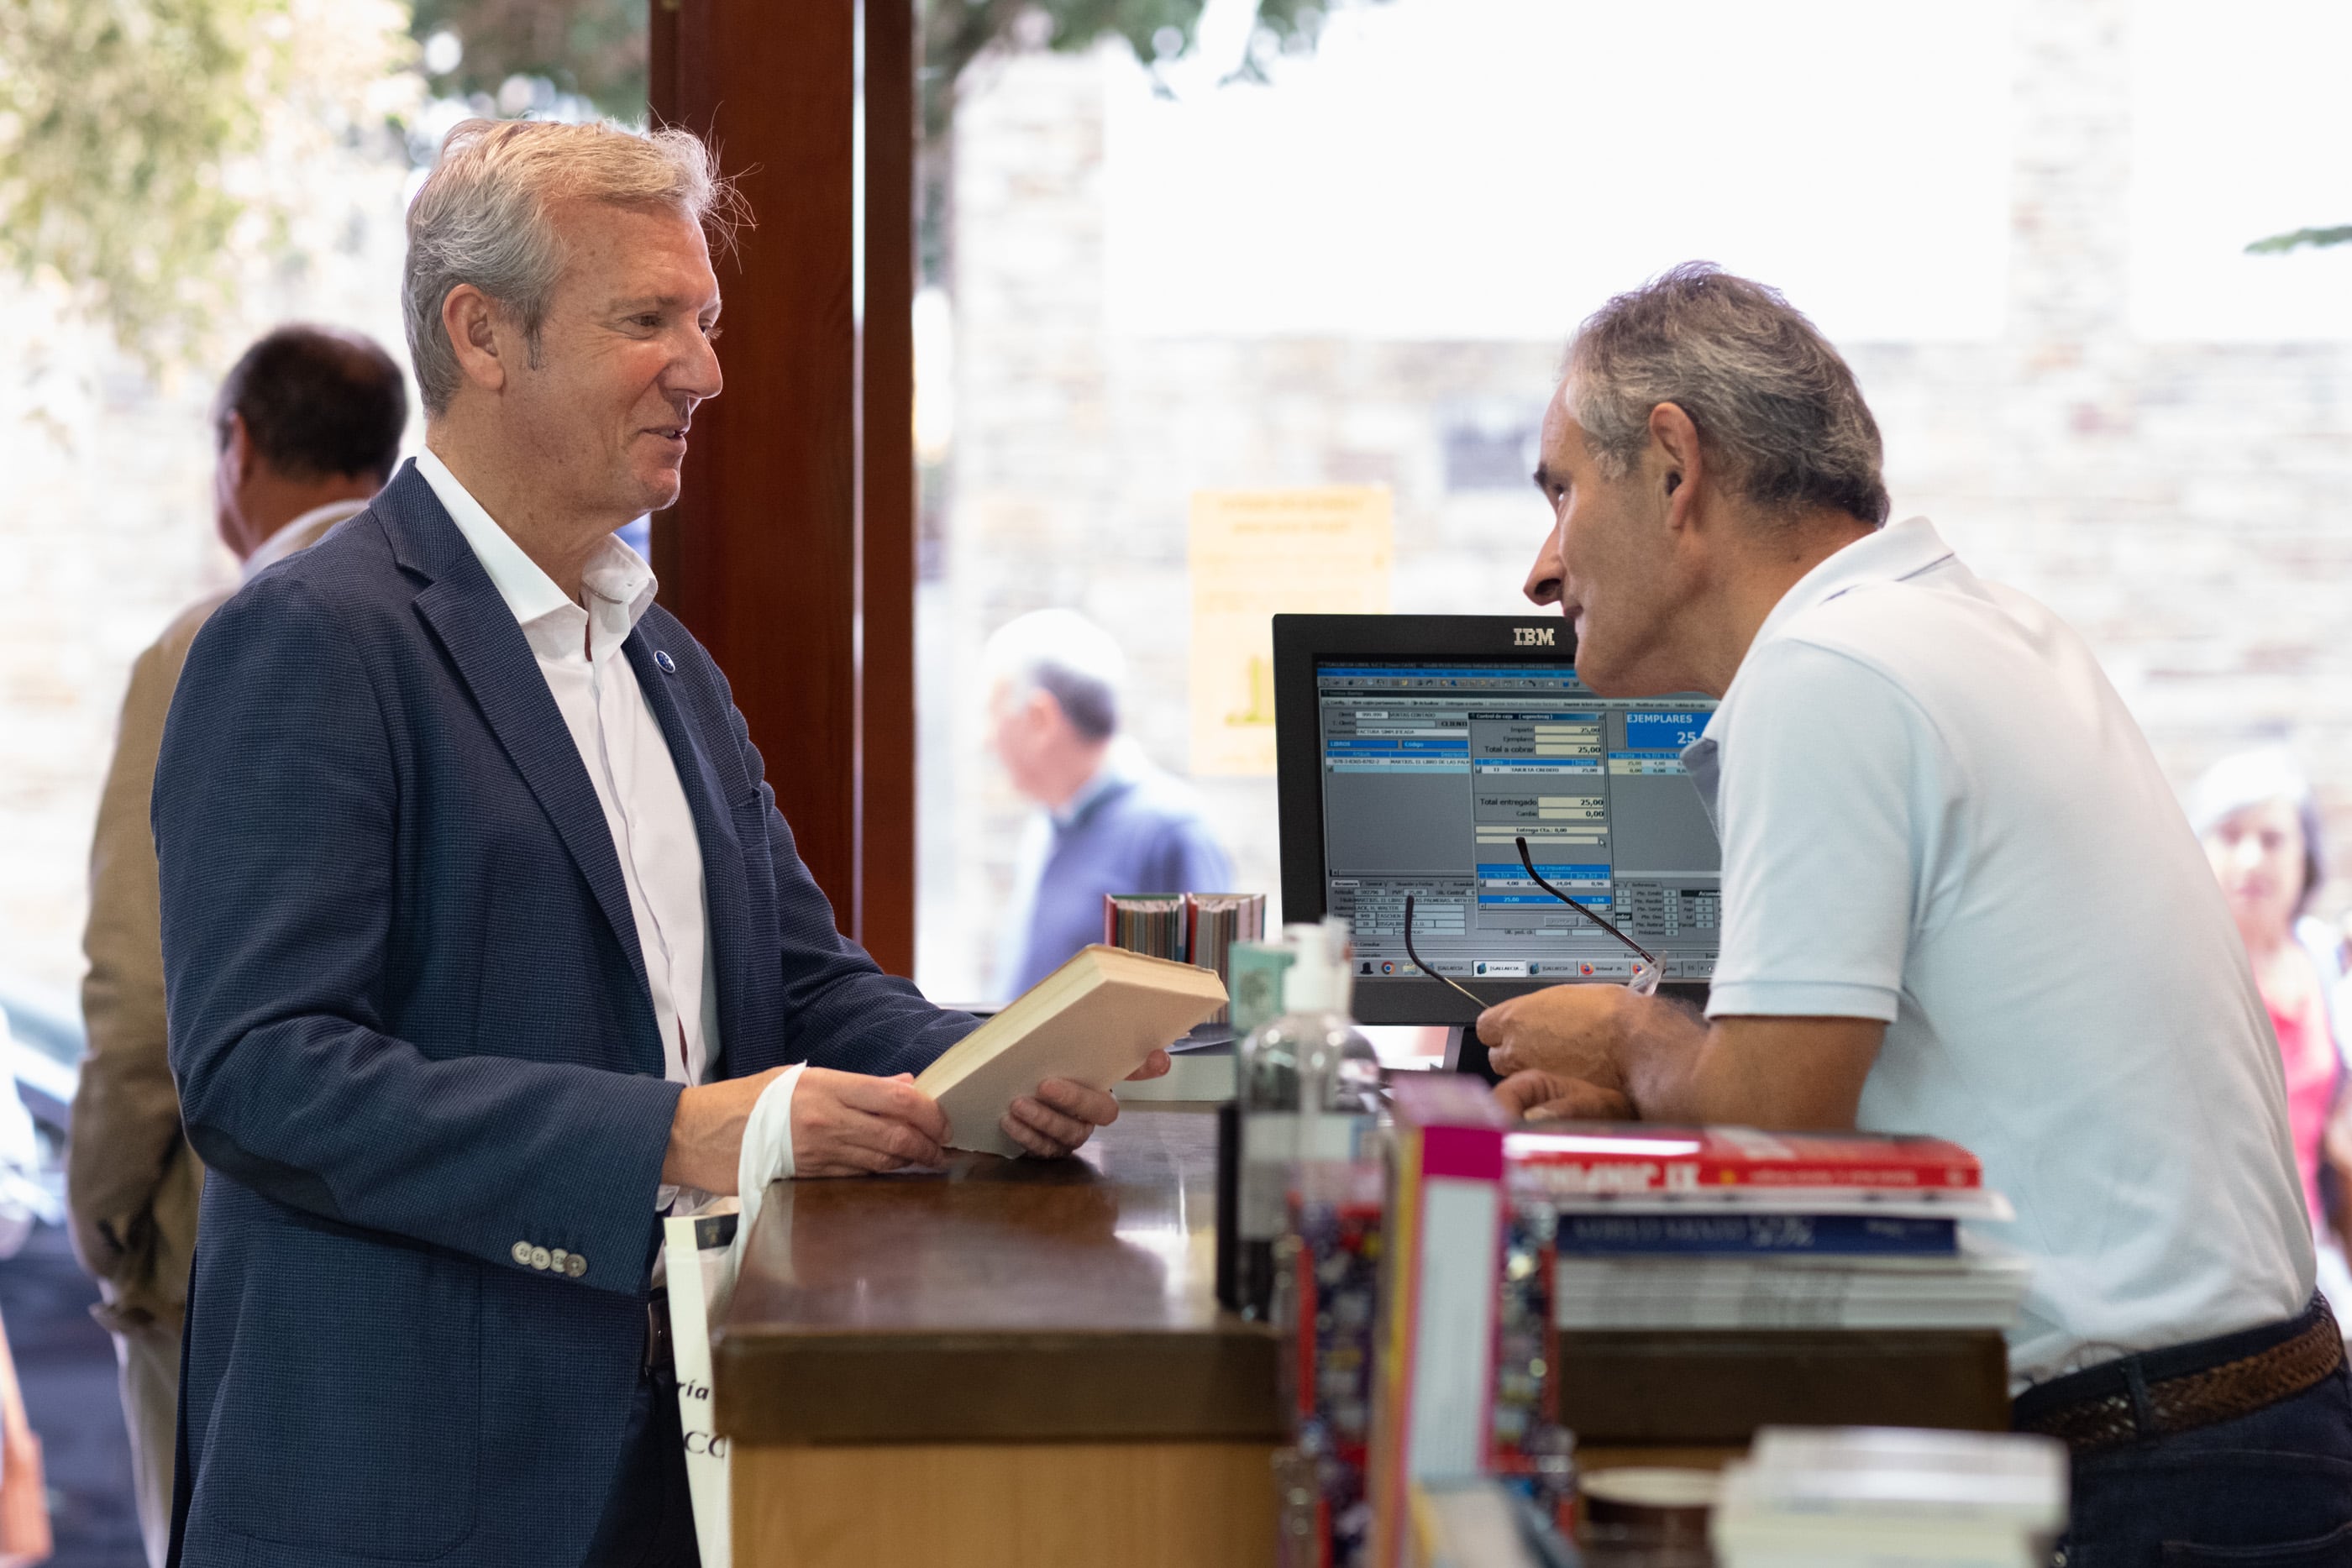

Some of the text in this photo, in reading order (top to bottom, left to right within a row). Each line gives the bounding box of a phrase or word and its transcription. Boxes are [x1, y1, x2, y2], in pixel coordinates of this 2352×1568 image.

[1513, 627, 1556, 646] IBM
[1626, 714, 1693, 726] EJEMPLARES
[1484, 745, 1502, 754] Total
[1510, 745, 1535, 754] cobrar
[1577, 745, 1602, 755] 25,00
[1479, 797, 1538, 808] Total entregado
[1579, 798, 1604, 808] 25,00
[1584, 810, 1604, 819] 0,00
